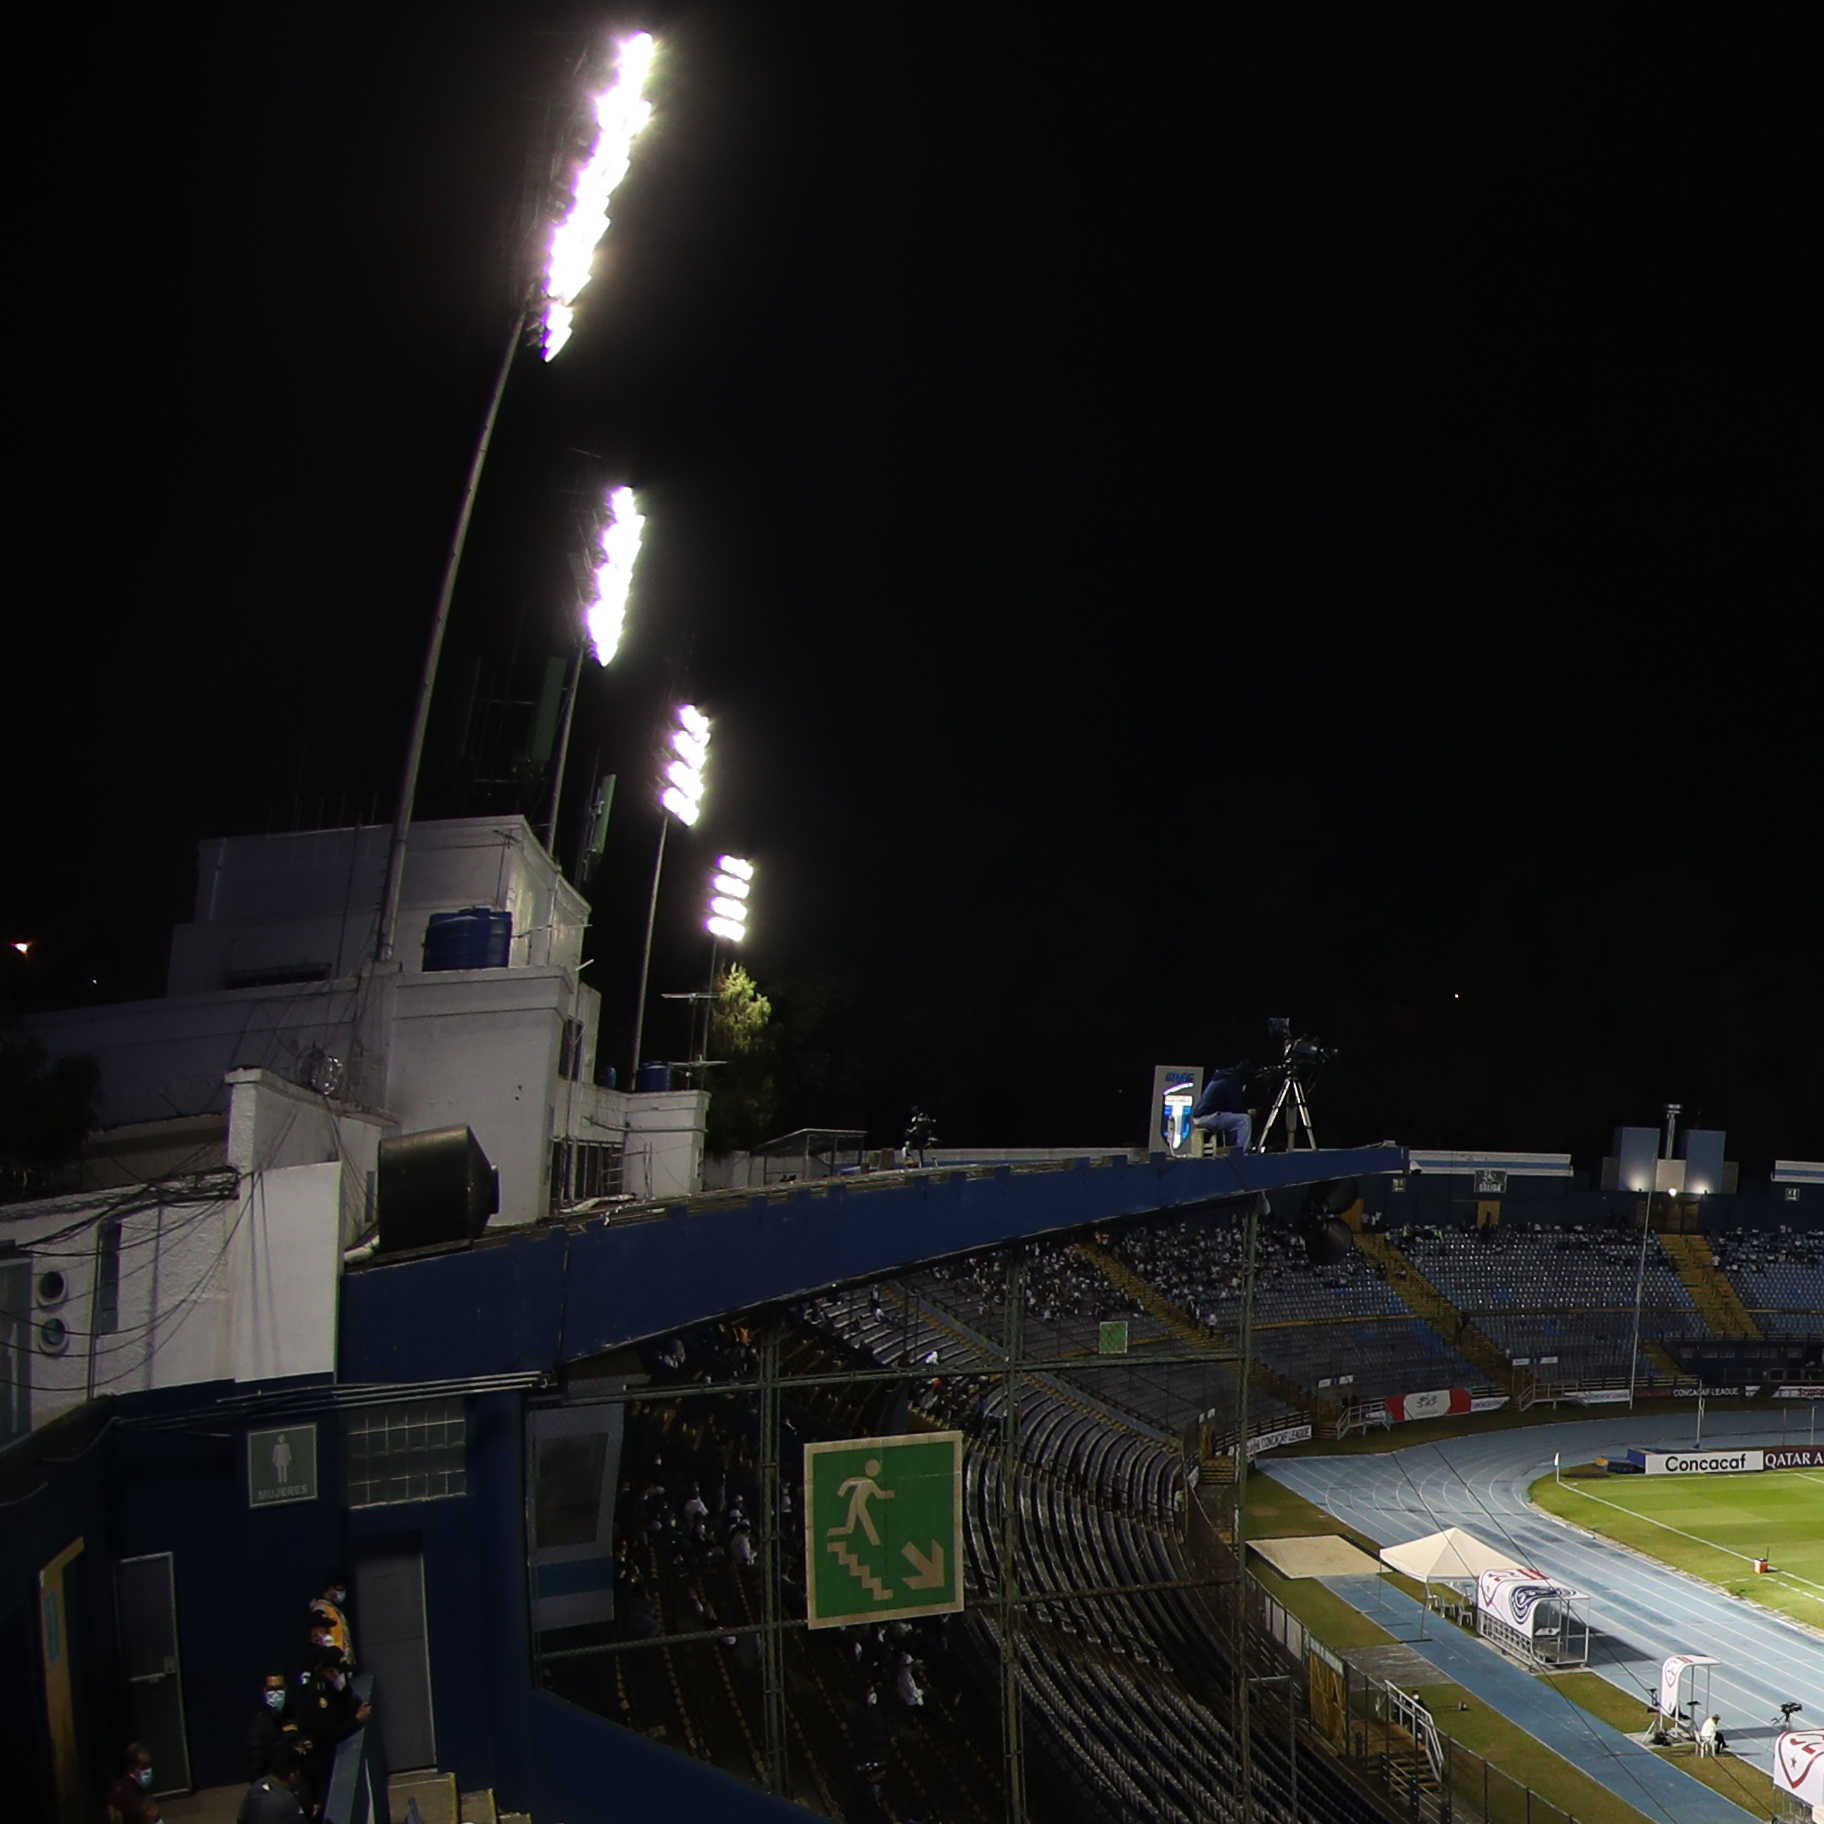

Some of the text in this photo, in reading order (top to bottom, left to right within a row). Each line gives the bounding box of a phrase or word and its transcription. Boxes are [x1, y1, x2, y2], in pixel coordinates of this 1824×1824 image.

[1712, 1387, 1739, 1397] LEAGUE
[1665, 1453, 1746, 1473] Concacaf
[1765, 1452, 1811, 1469] QATAR
[257, 1484, 308, 1500] MUJERES
